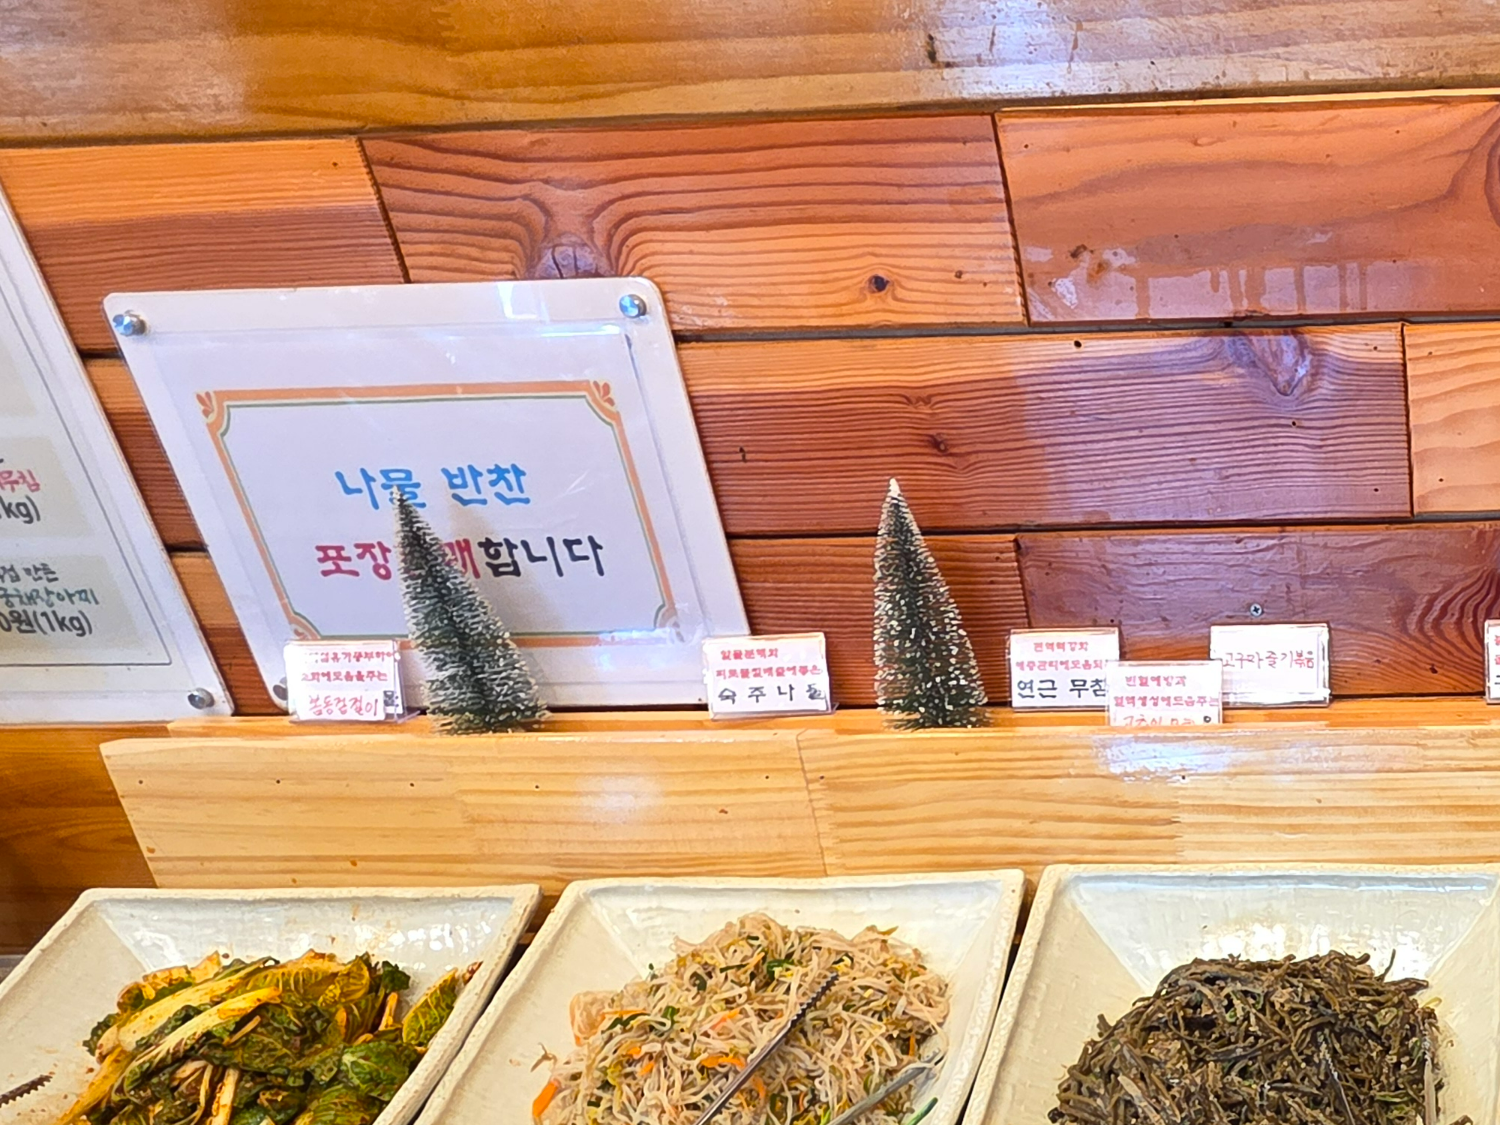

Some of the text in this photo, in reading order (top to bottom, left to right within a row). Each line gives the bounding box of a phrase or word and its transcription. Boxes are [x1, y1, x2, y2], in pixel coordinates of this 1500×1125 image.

[335, 463, 531, 510] 나물 반찬
[315, 535, 605, 581] 포장매합니다
[1015, 659, 1103, 671] 체중관리에도움되
[1017, 679, 1058, 699] 연근
